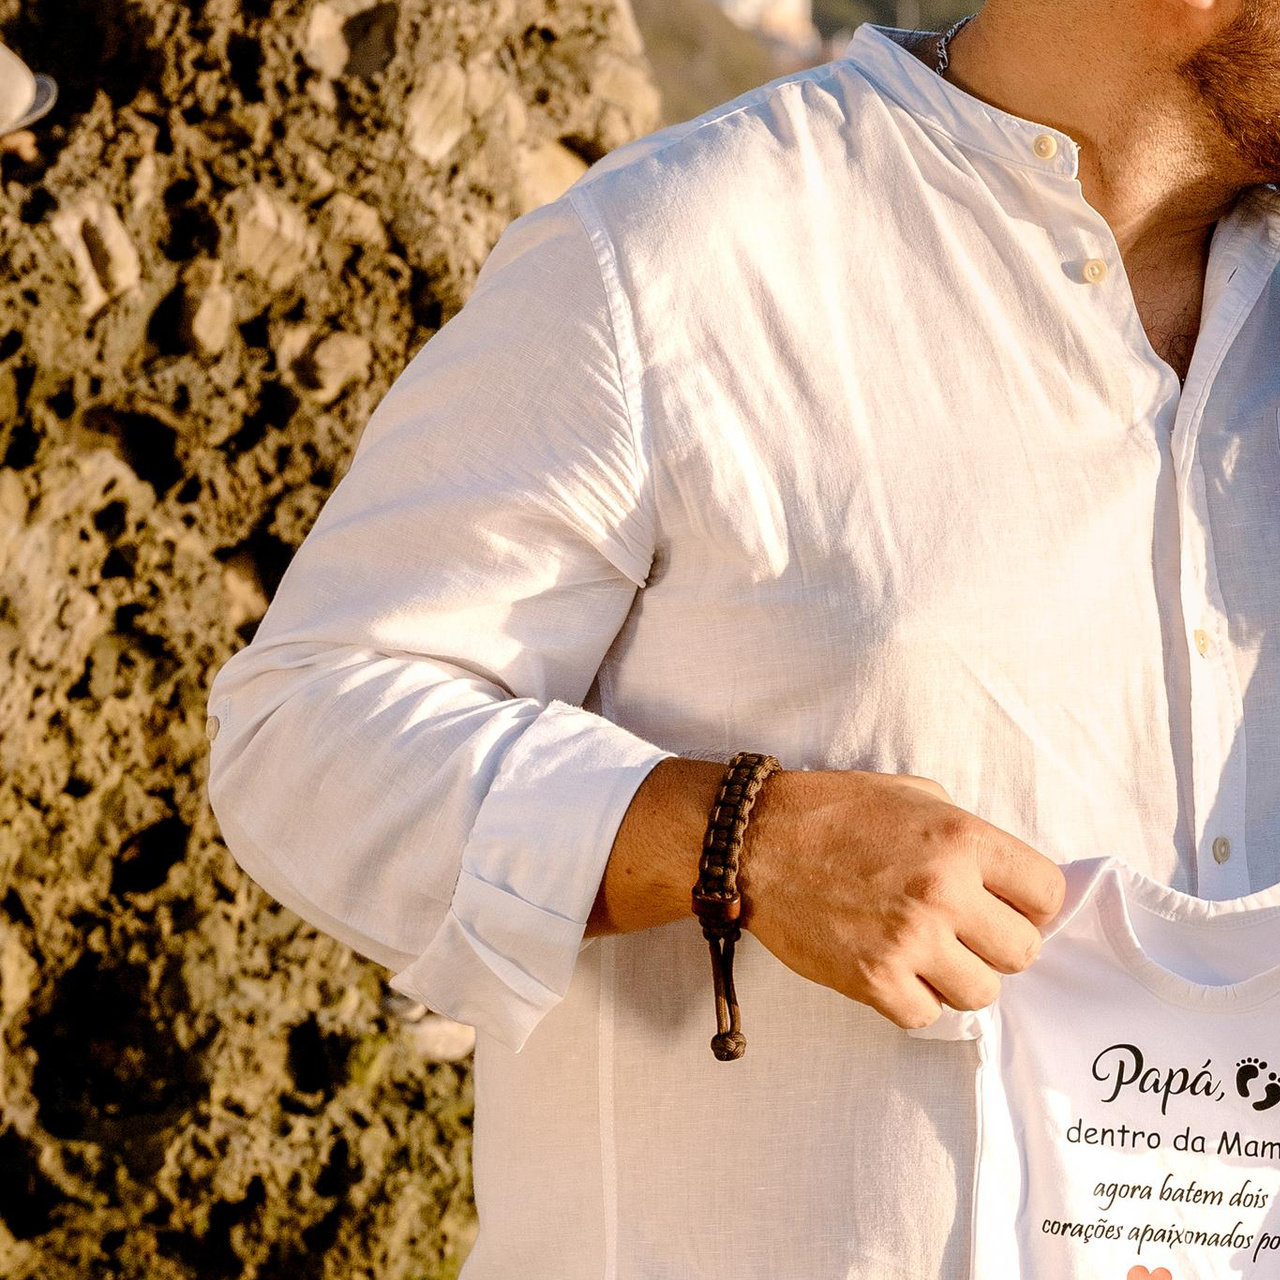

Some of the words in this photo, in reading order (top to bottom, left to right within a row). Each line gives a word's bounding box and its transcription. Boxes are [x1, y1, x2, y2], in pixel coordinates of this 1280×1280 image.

[1091, 1043, 1225, 1116] Papá,
[1066, 1118, 1161, 1150] dentro
[1173, 1126, 1206, 1153] da
[1093, 1181, 1152, 1211] agora
[1159, 1173, 1223, 1206] batem
[1228, 1179, 1269, 1209] dois
[1041, 1218, 1124, 1244] corações
[1127, 1221, 1254, 1255] apaixonados
